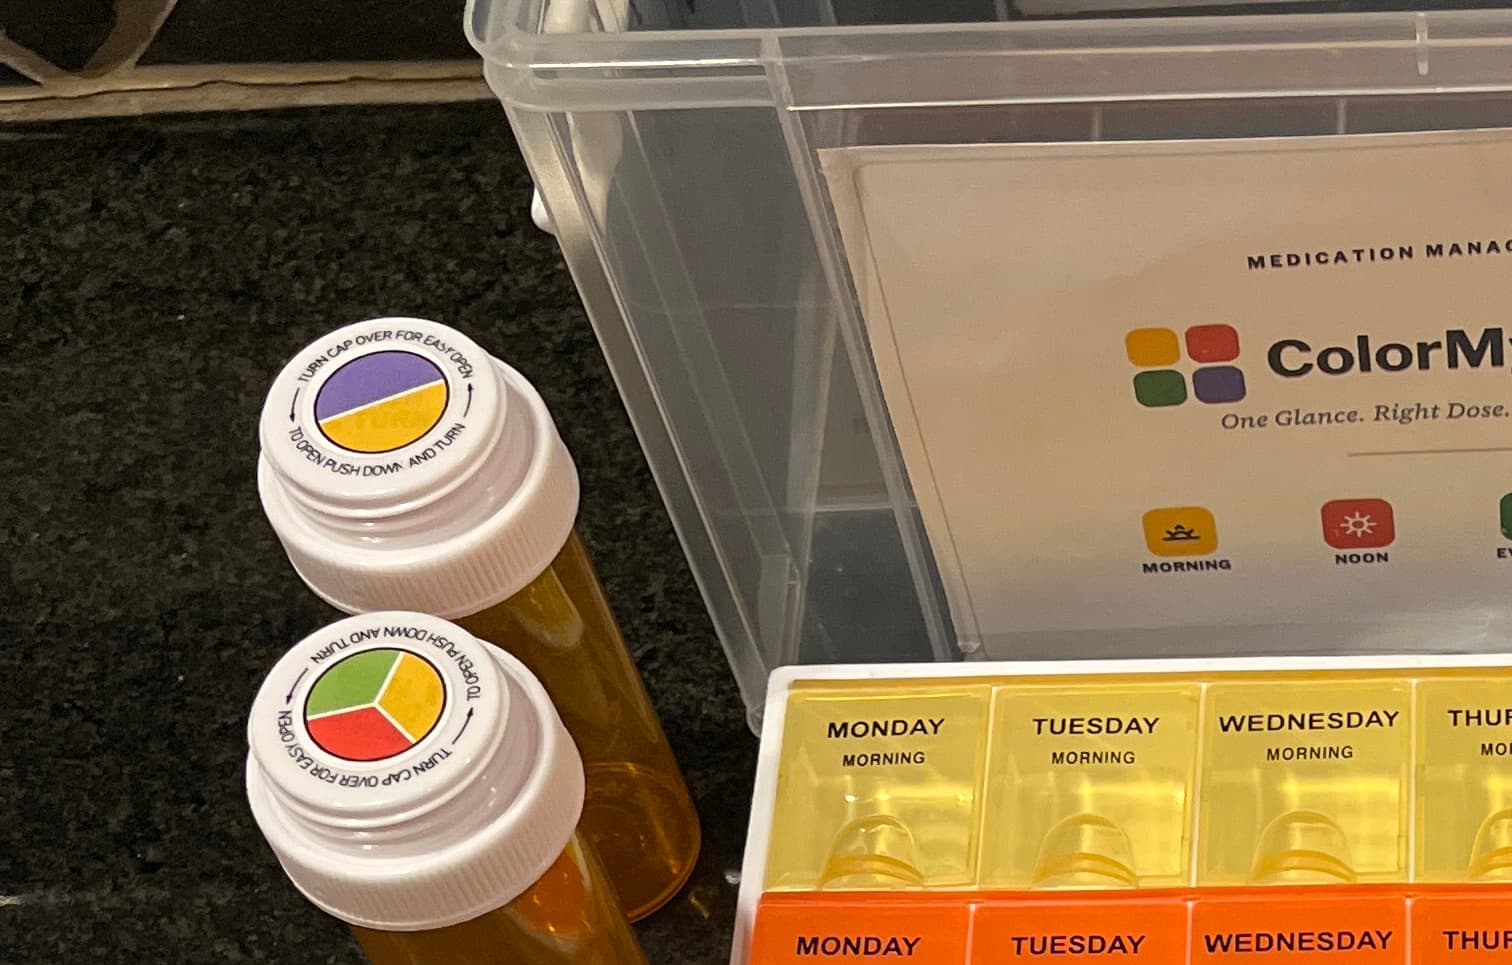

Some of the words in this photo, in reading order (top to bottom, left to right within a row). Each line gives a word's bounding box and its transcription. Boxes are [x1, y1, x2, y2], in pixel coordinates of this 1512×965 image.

[1247, 246, 1413, 270] MEDICATION
[298, 355, 330, 383] TURN
[326, 340, 354, 359] CAP
[355, 330, 393, 346] OVER
[395, 330, 424, 343] FOR
[1221, 414, 1268, 430] One
[1275, 408, 1364, 427] Glance.
[1374, 402, 1440, 424] Right
[1447, 401, 1510, 420] Dose.
[296, 440, 331, 467] OPEN
[323, 458, 361, 477] PUSH
[409, 448, 437, 469] AND
[433, 423, 466, 451] TURN
[1142, 559, 1231, 574] MORNING
[1335, 552, 1389, 565] NOON
[349, 627, 381, 645] AND
[383, 626, 432, 642] DOWN
[310, 637, 352, 665] TURN
[278, 710, 296, 743] OPEN
[827, 718, 945, 739] MONDAY
[1032, 717, 1160, 735] TUESDAY
[1219, 710, 1400, 733] WEDNESDAY
[285, 743, 315, 771] EASY
[412, 748, 453, 777] TURN
[842, 751, 925, 767] MORNING
[1051, 751, 1135, 765] MORNING
[1266, 745, 1353, 761] MORNING
[310, 764, 344, 785] FOR
[339, 774, 379, 788] OVER
[382, 769, 413, 787] CAP
[796, 936, 921, 956] MONDAY
[1011, 935, 1145, 956] TUESDAY
[1204, 930, 1393, 953] WEDNESDAY
